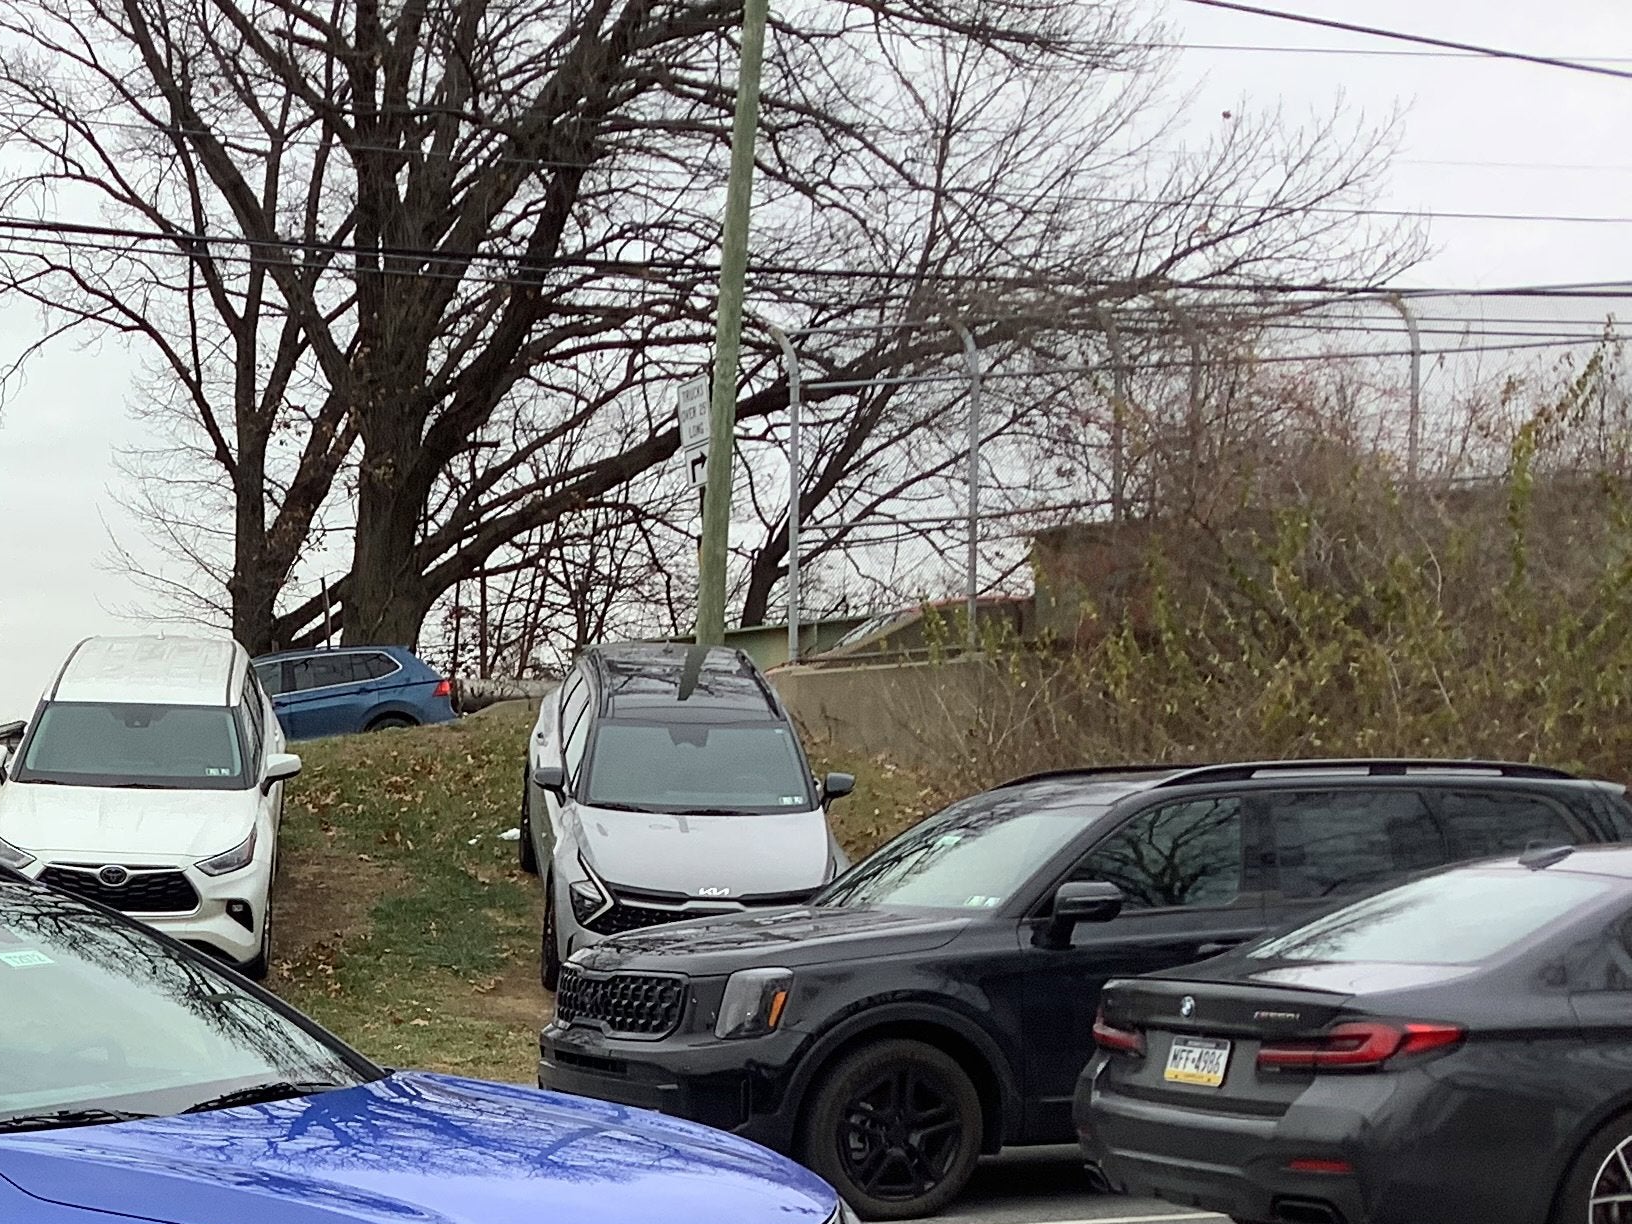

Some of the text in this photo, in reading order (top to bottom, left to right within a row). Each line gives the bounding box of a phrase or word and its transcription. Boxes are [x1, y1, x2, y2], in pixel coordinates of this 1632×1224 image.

[682, 384, 704, 402] TRUCKS
[681, 405, 696, 423] OVER
[688, 422, 704, 439] LONG
[698, 887, 730, 896] KIA
